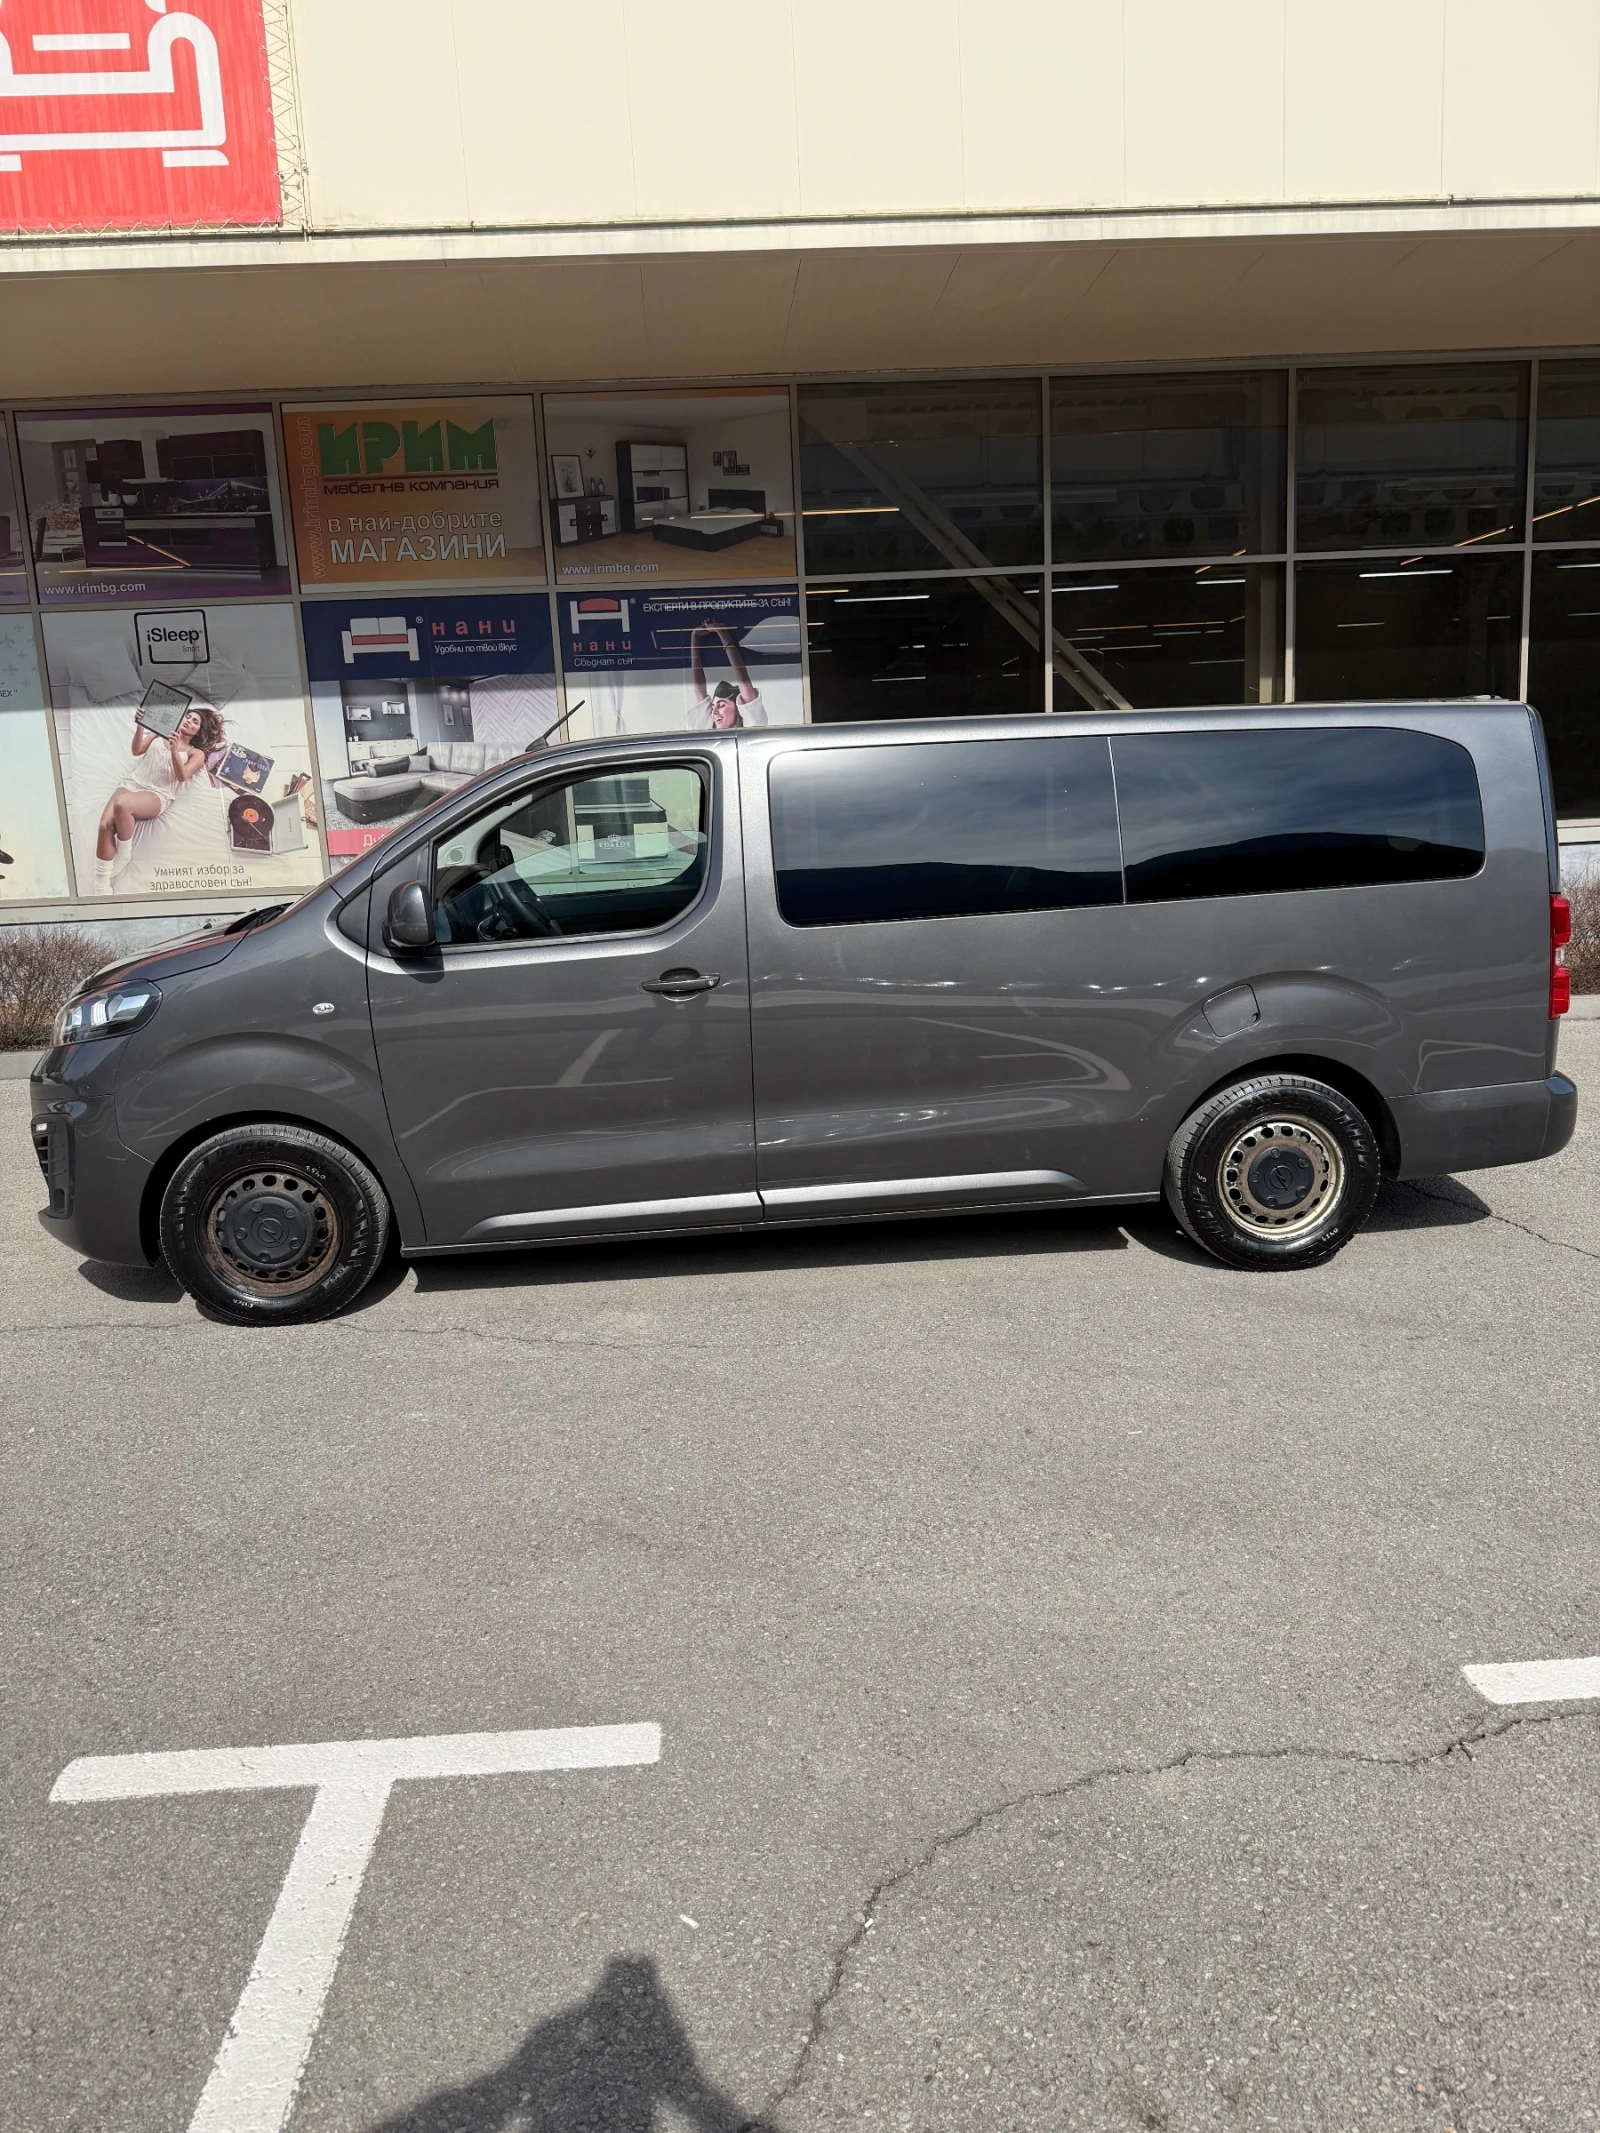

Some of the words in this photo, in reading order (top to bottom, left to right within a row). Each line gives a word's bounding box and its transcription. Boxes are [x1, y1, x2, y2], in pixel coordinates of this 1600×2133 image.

[318, 418, 499, 476] ИРИМ
[324, 481, 405, 495] мебелна
[409, 479, 499, 492] компания
[297, 416, 326, 579] www.irimbg.com
[327, 518, 341, 533] в
[348, 509, 502, 534] най-добрите
[329, 533, 507, 564] МАГАЗИНИ
[562, 563, 659, 575] www.irimbg.com
[44, 582, 146, 595] www.irimbg.com
[146, 627, 200, 644] iSleep
[153, 866, 193, 877] Умният
[197, 864, 230, 876] избор
[232, 864, 245, 874] за
[149, 879, 227, 891] здравословен
